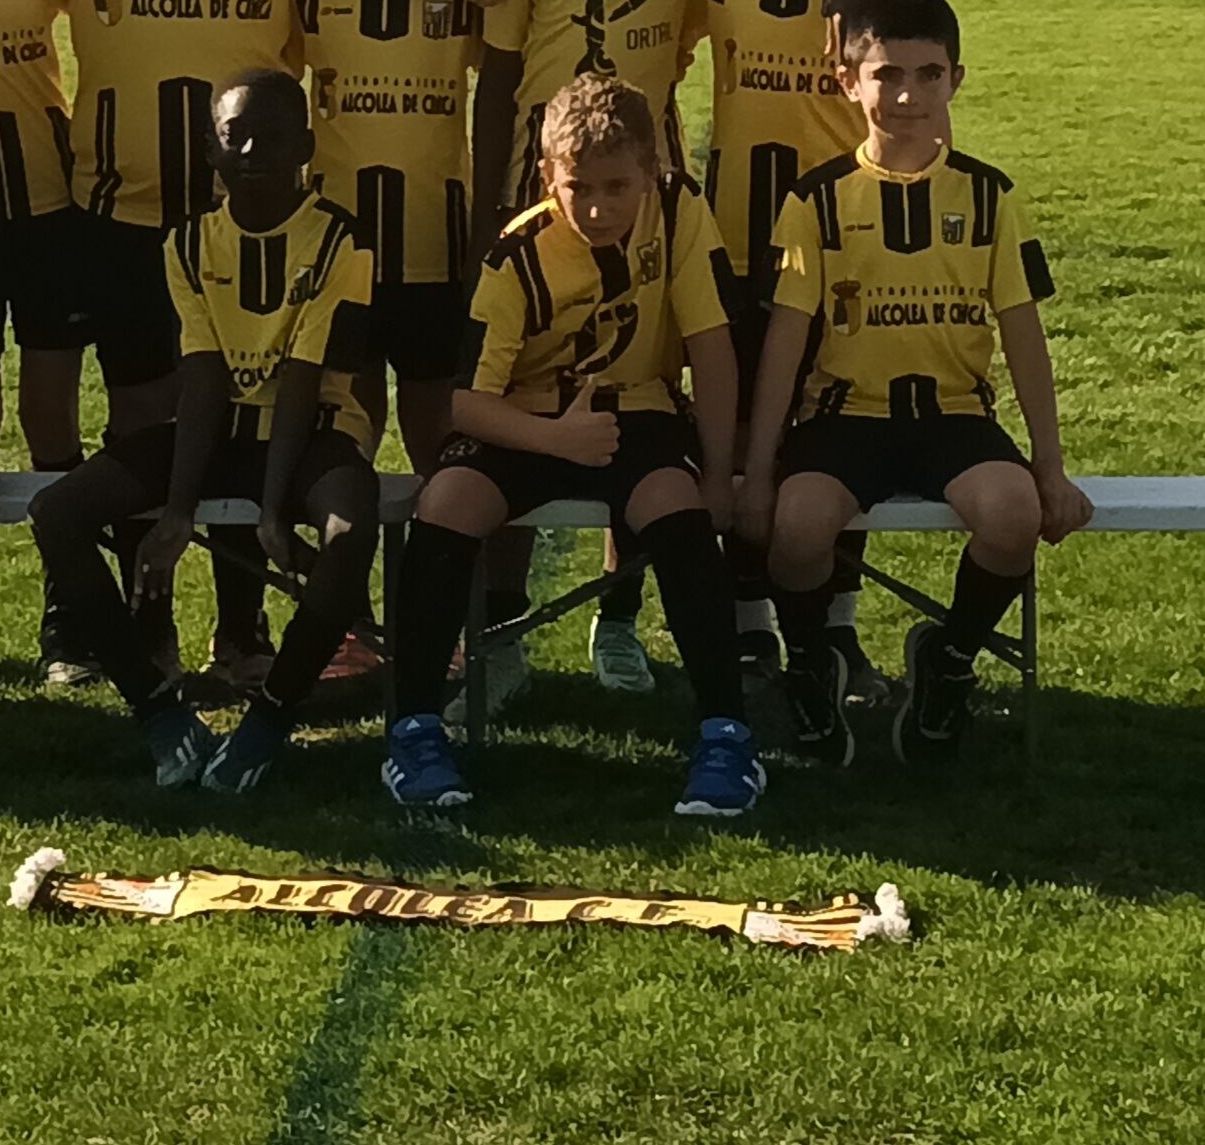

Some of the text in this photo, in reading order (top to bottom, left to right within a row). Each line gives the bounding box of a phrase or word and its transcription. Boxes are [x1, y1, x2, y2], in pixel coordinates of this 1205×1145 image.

[740, 67, 791, 91] ALCOLEA
[796, 72, 813, 93] DE
[341, 92, 397, 114] ALCOLEA
[402, 93, 418, 114] DE
[866, 303, 928, 326] ALCOLEA
[210, 883, 533, 923] ALCOLEA
